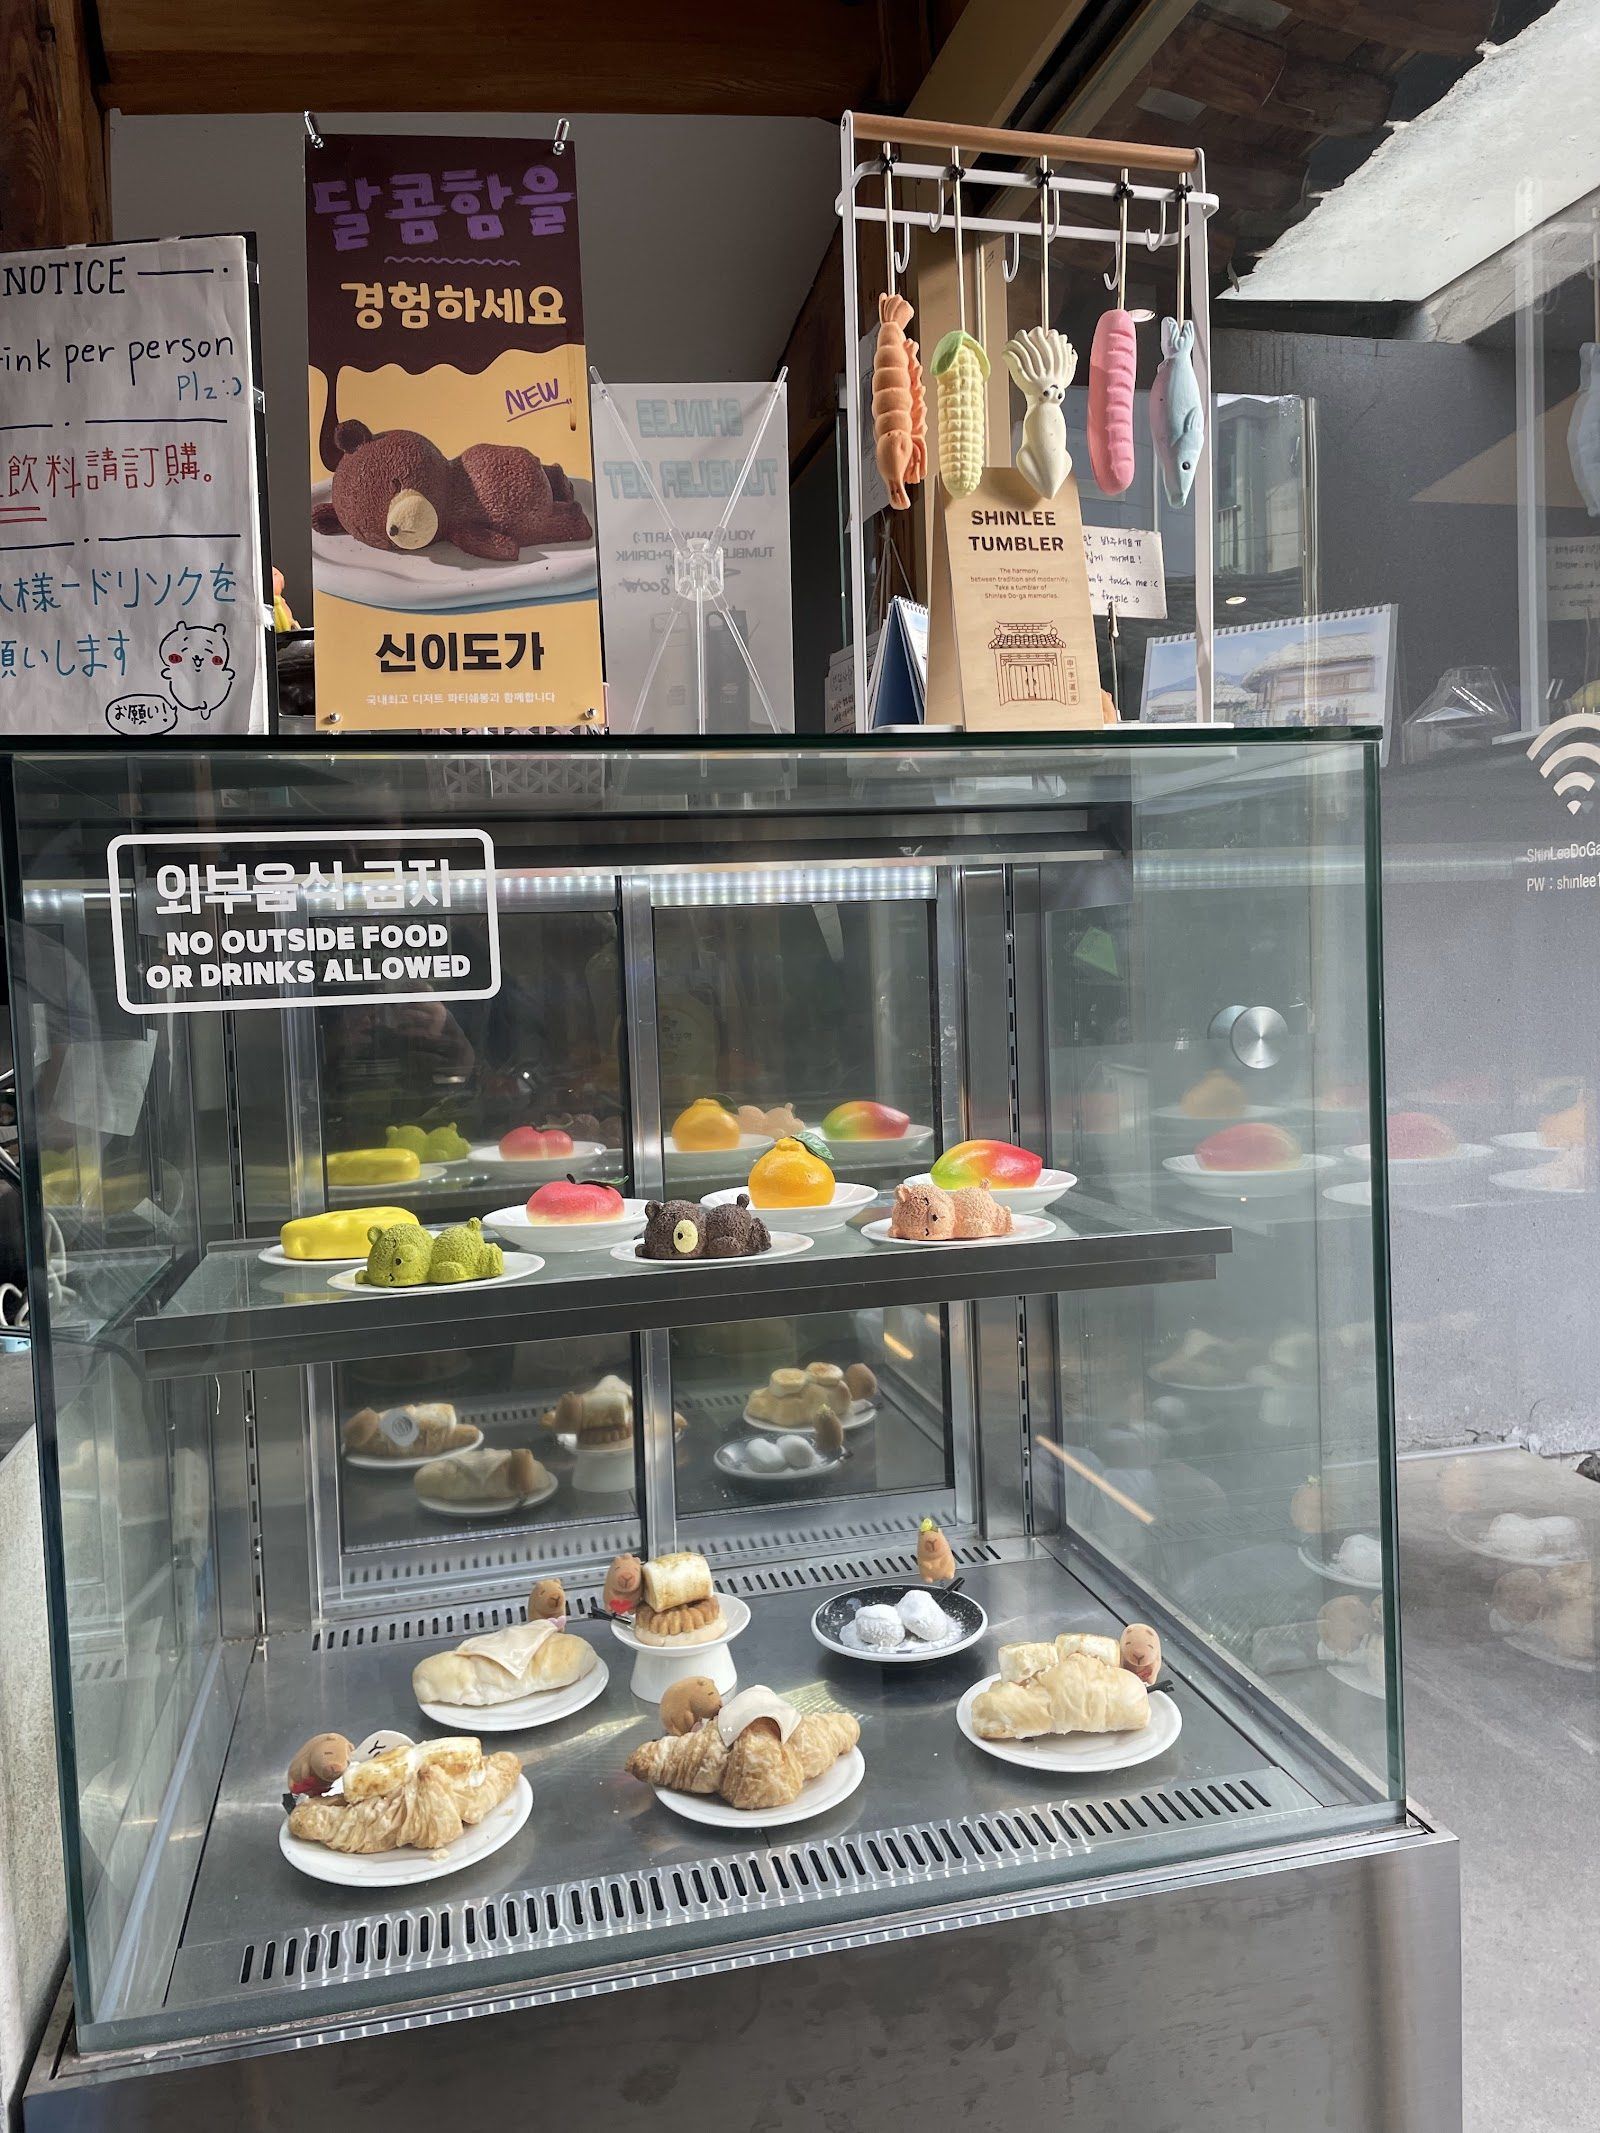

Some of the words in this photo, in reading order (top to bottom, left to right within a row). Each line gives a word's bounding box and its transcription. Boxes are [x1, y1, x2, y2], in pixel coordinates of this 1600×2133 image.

[312, 164, 576, 251] 달콤함을
[2, 257, 126, 297] NOTICE
[341, 281, 567, 330] 경험하세요
[0, 339, 51, 373] ink
[65, 344, 115, 384] per
[129, 336, 234, 386] person
[505, 378, 559, 414] NEW
[0, 442, 213, 498] 飲料請訂購。
[971, 510, 1057, 527] SHINLEE
[968, 536, 1064, 552] TUMBLER
[1012, 567, 1039, 575] harmony
[1007, 593, 1027, 601] Do-ga
[375, 631, 545, 673] 신이도가
[367, 694, 409, 705] 국내최고
[412, 693, 445, 705] 디저트
[503, 691, 556, 704] 함께합니다
[156, 860, 345, 915] 외부음식
[363, 858, 452, 909] 금지
[1527, 876, 1545, 892] PW
[166, 930, 214, 956] NO
[221, 926, 355, 954] OUTSIDE
[361, 923, 449, 950] FOOD
[146, 964, 193, 989] OR
[200, 959, 316, 988] DRINKS
[322, 954, 471, 983] ALLOWED
